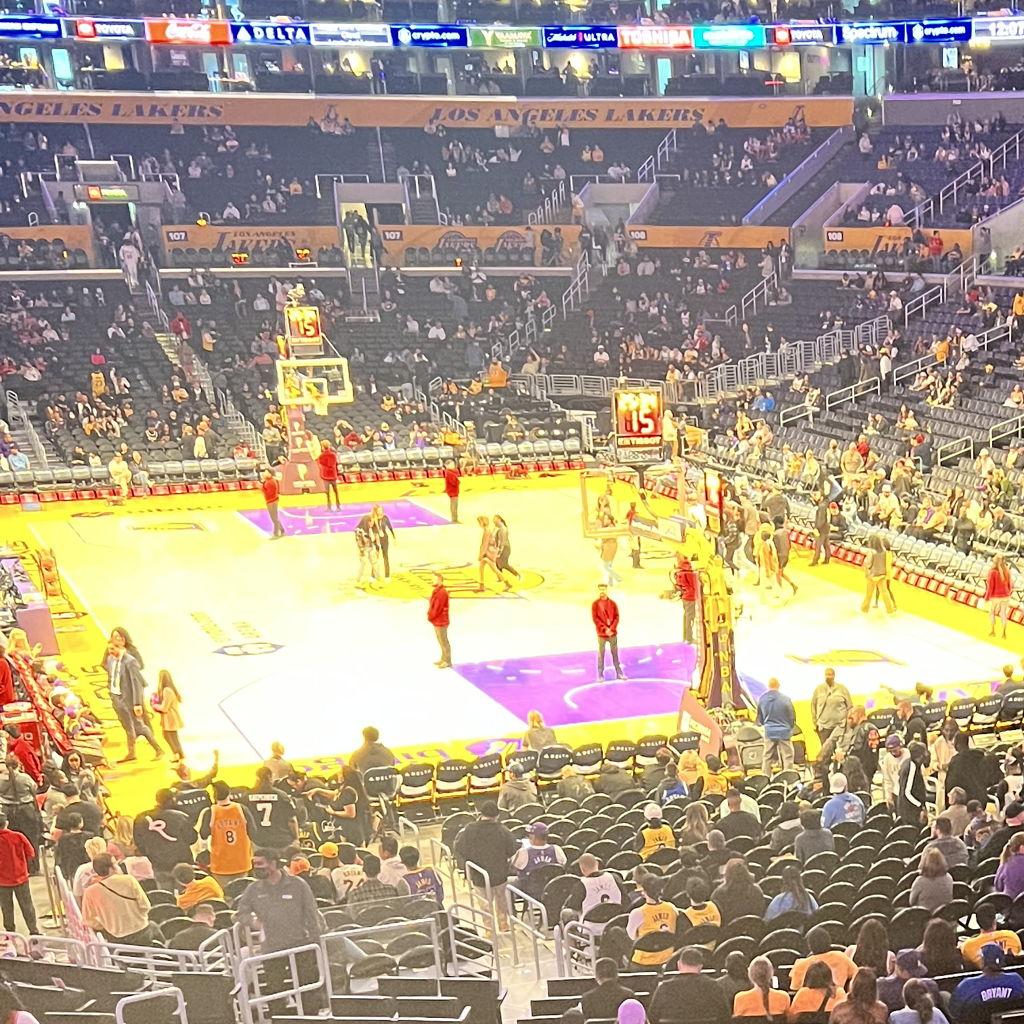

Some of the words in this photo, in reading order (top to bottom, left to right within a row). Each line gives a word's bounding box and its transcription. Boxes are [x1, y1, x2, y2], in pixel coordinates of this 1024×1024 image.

[95, 24, 134, 35] TOYOTA
[253, 25, 307, 40] DELTA
[412, 32, 460, 41] crypto.com
[792, 29, 824, 40] TOYOTA
[842, 25, 897, 40] Spectrum
[584, 33, 615, 42] ULTRA
[621, 29, 691, 45] TOSHIBA
[111, 103, 225, 118] LAKERS
[432, 108, 481, 121] LOS
[486, 108, 599, 122] ANGELES
[604, 108, 705, 122] LAKERS
[168, 231, 187, 241] 107
[384, 231, 401, 240] 107
[298, 319, 316, 336] 15
[631, 409, 655, 434] 15
[256, 803, 272, 827] 7
[225, 830, 237, 845] 8
[981, 987, 1013, 1001] BRYANT
